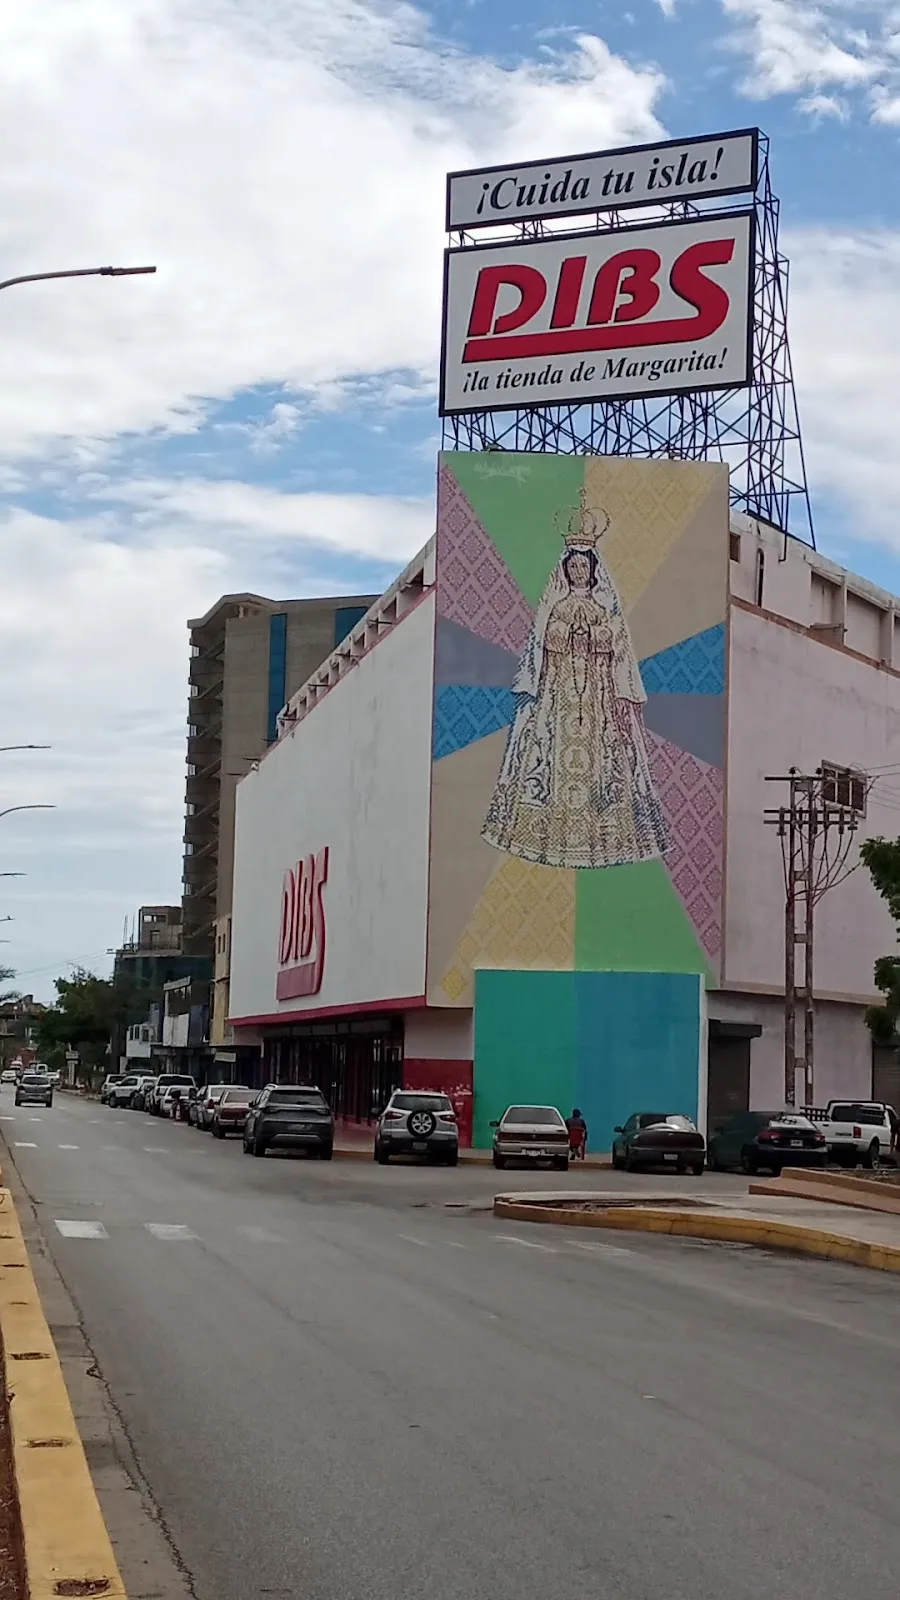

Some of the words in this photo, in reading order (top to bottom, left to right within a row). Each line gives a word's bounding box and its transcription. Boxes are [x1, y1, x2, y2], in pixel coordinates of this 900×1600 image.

[477, 170, 590, 214] ¡Cuida
[602, 168, 633, 194] tu
[647, 147, 724, 188] isla!
[462, 238, 735, 363] DIBS
[463, 372, 489, 392] ¡la
[496, 363, 562, 390] tienda
[569, 361, 595, 381] de
[602, 348, 727, 380] Margarita!
[277, 846, 329, 1001] DIBS
